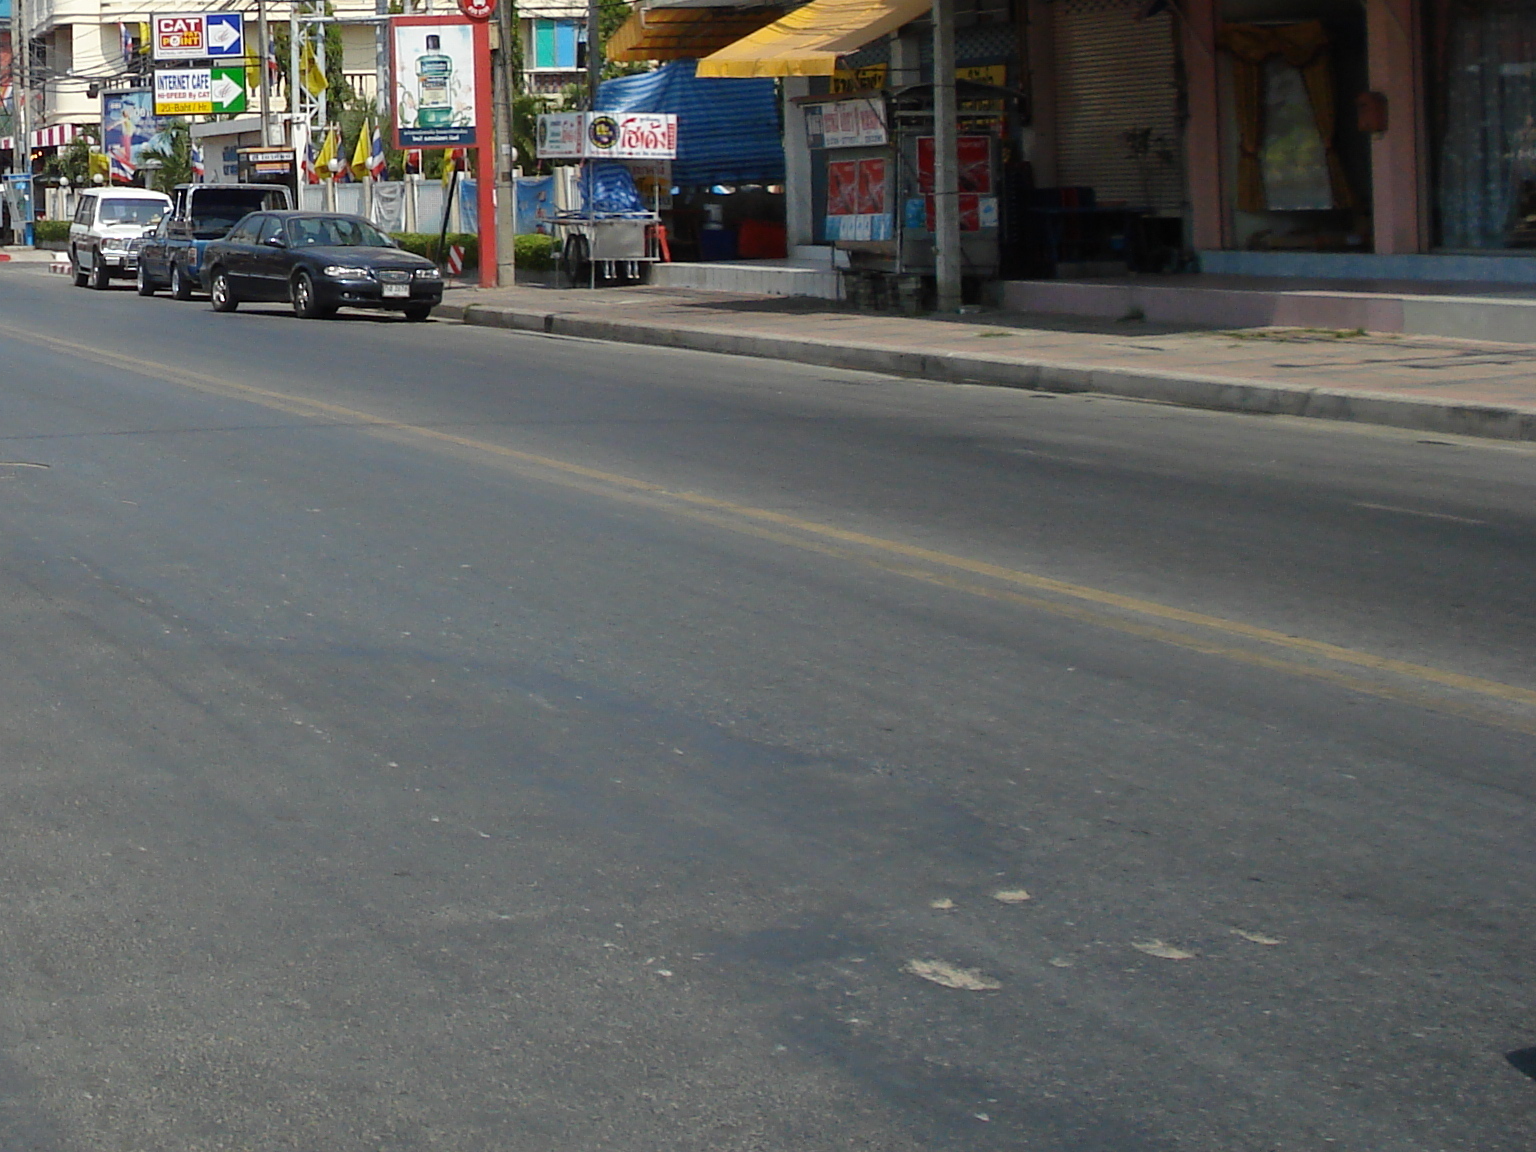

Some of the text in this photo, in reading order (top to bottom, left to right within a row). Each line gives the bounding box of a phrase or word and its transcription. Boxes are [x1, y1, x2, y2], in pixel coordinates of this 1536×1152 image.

[160, 19, 199, 32] CAT
[162, 35, 199, 47] POINT
[157, 74, 210, 90] INTERNET CAFE
[188, 91, 196, 100] By
[198, 90, 210, 98] CAT
